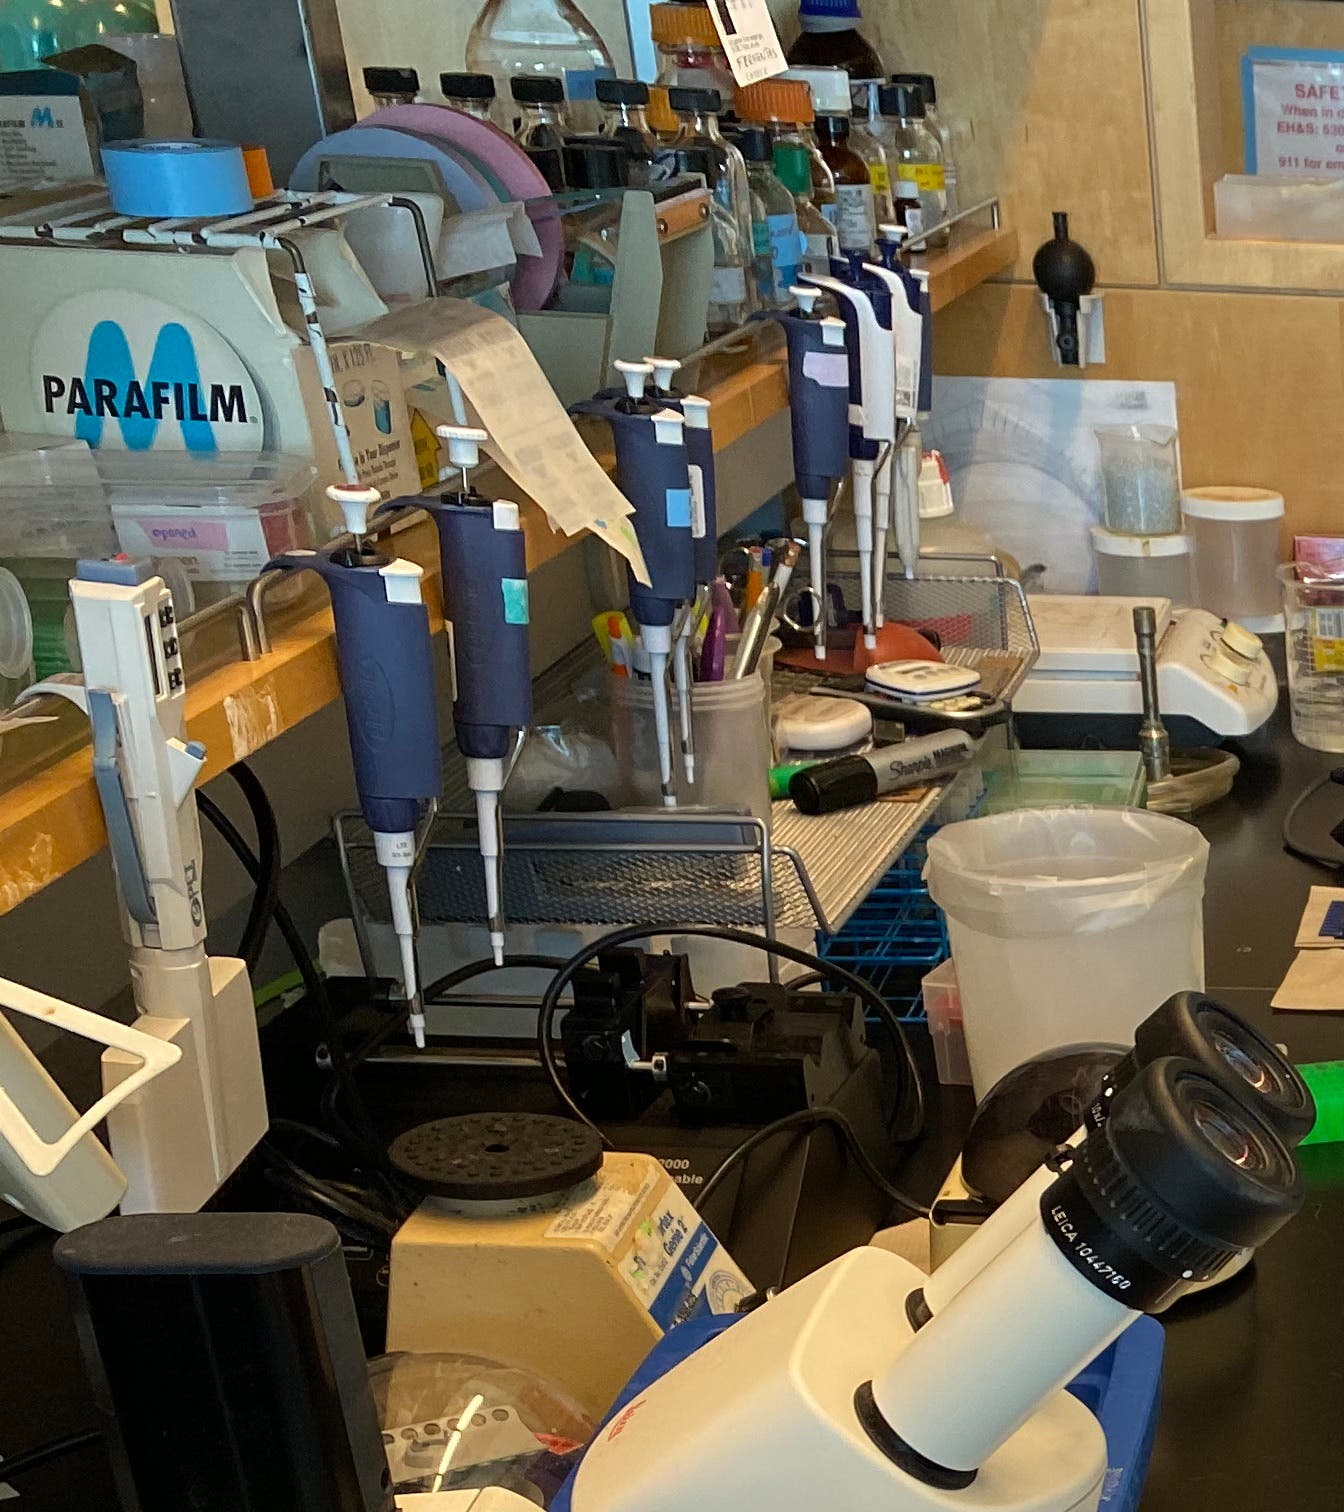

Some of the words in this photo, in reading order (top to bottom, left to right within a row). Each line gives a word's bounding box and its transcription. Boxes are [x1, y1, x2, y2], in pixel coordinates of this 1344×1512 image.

[1281, 104, 1317, 117] When
[1322, 107, 1333, 118] in
[1279, 157, 1299, 168] 911
[1304, 157, 1321, 168] for
[43, 374, 248, 424] PARAFILM
[152, 527, 196, 541] opened
[1051, 1205, 1078, 1242] LEICA
[1075, 1242, 1131, 1289] 10447160
